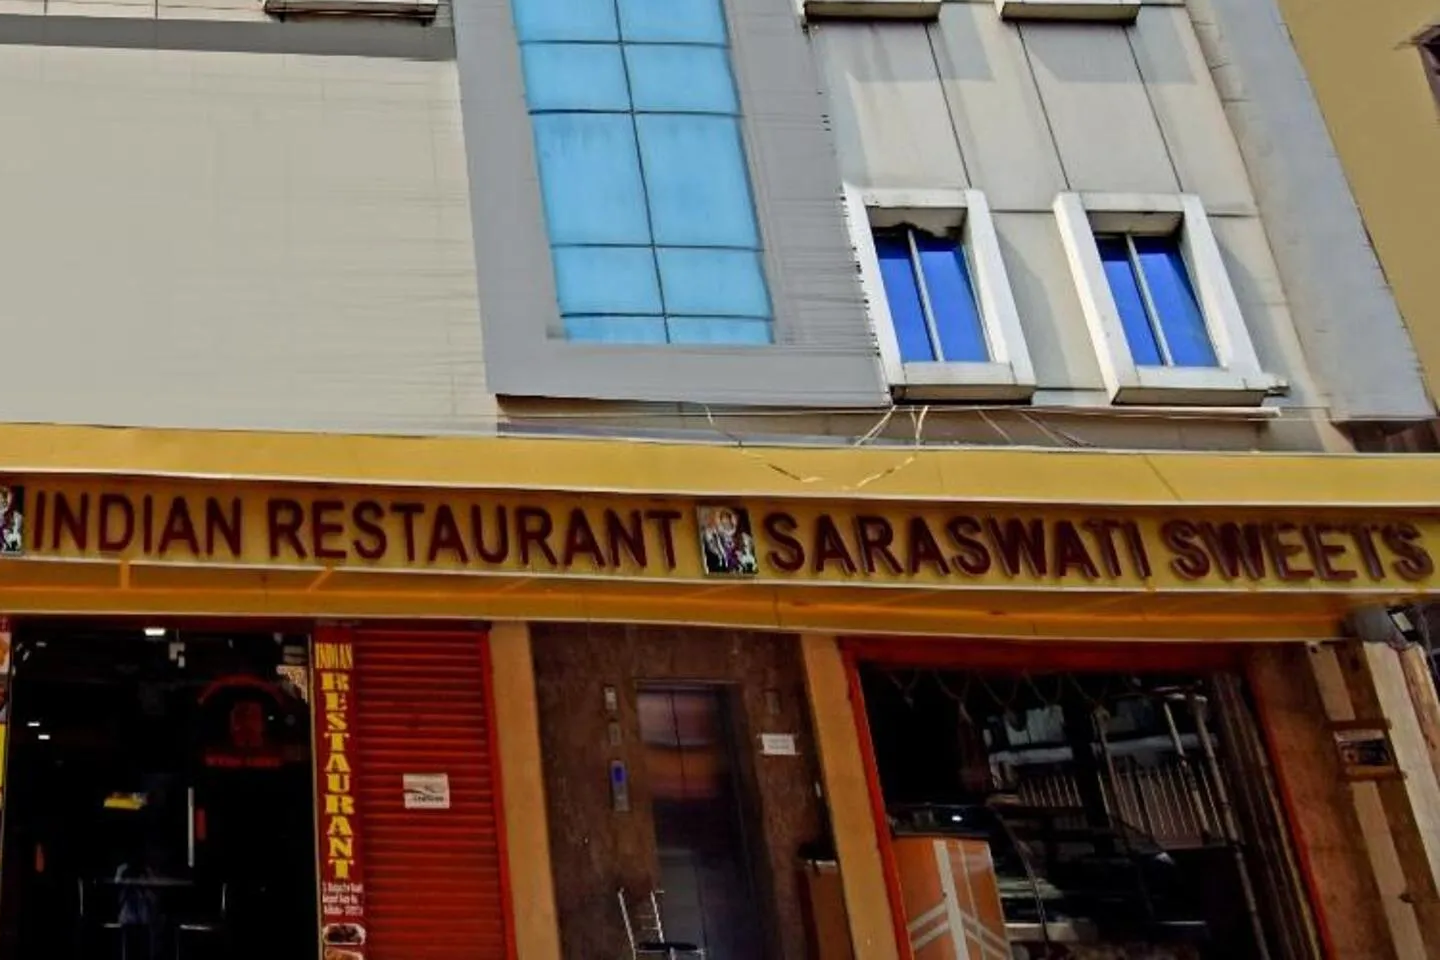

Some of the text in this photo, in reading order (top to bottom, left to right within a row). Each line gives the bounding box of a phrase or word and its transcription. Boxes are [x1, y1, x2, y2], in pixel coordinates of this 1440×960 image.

[33, 489, 682, 572] INDIAN RESTAURANT
[764, 512, 1435, 582] SARASWATI SWEETS
[320, 672, 355, 879] RESTAURANT
